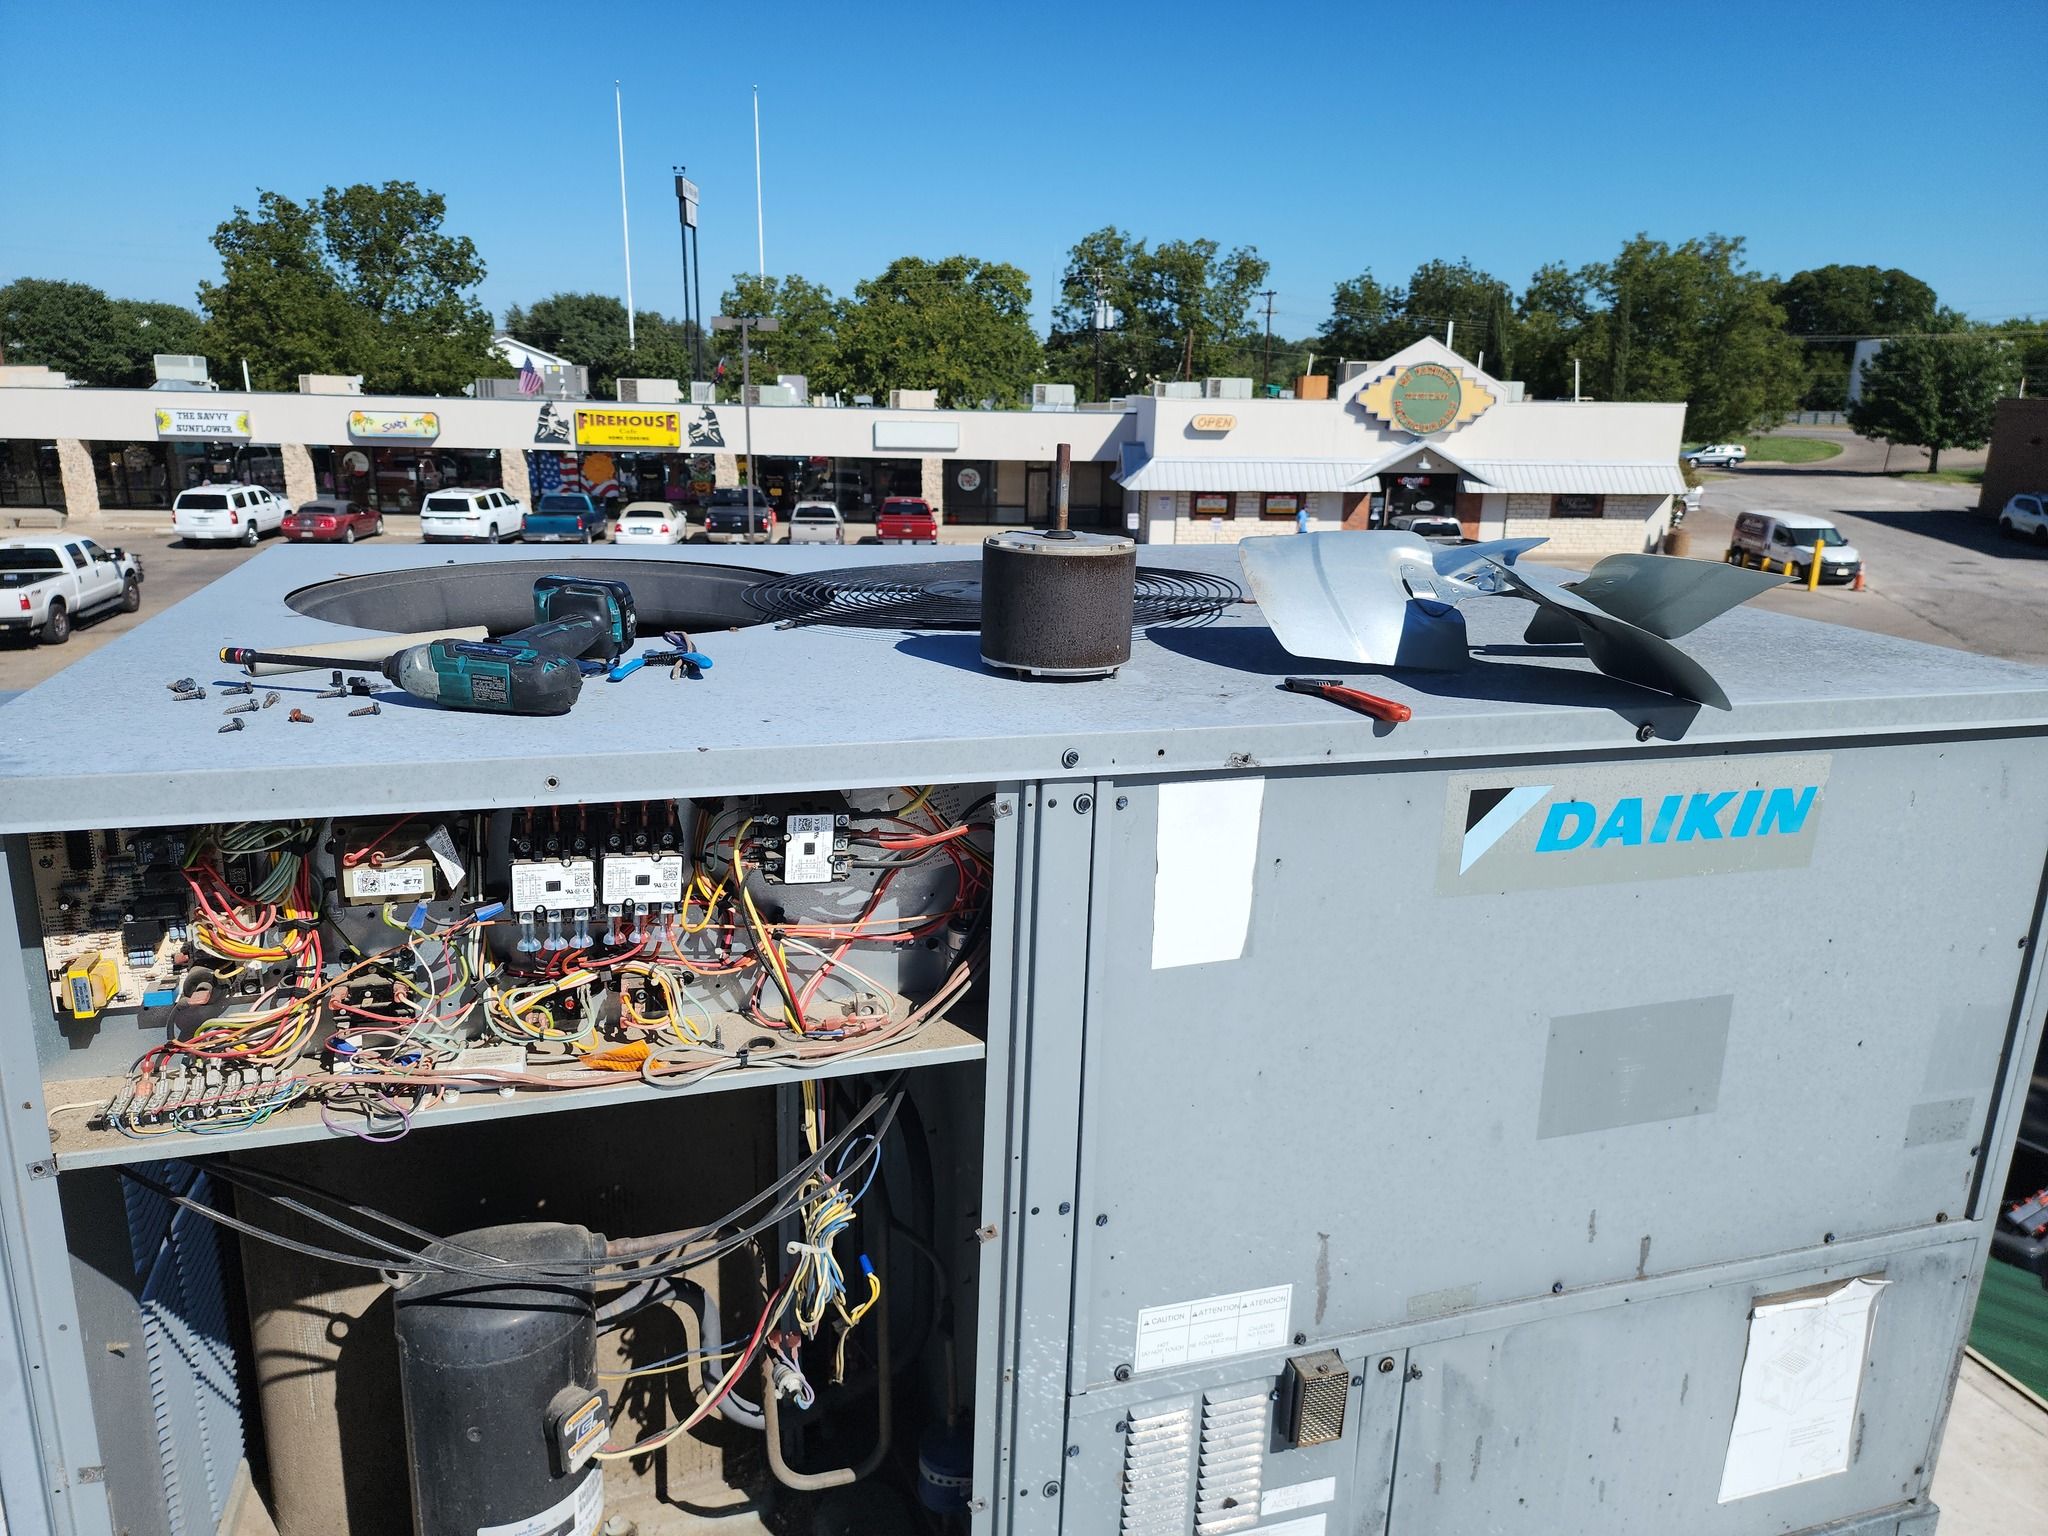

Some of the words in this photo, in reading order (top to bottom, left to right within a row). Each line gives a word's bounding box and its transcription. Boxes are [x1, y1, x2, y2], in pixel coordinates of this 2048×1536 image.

[176, 412, 194, 420] THE
[198, 412, 228, 421] SAVVY
[578, 412, 678, 432] FIREHOUSE
[1197, 416, 1232, 428] OPEN
[176, 424, 232, 433] SUNFLOWER
[1536, 786, 1818, 852] DAIKIN
[1151, 1312, 1185, 1326] CAUTION
[1198, 1303, 1240, 1316] ATTENTION
